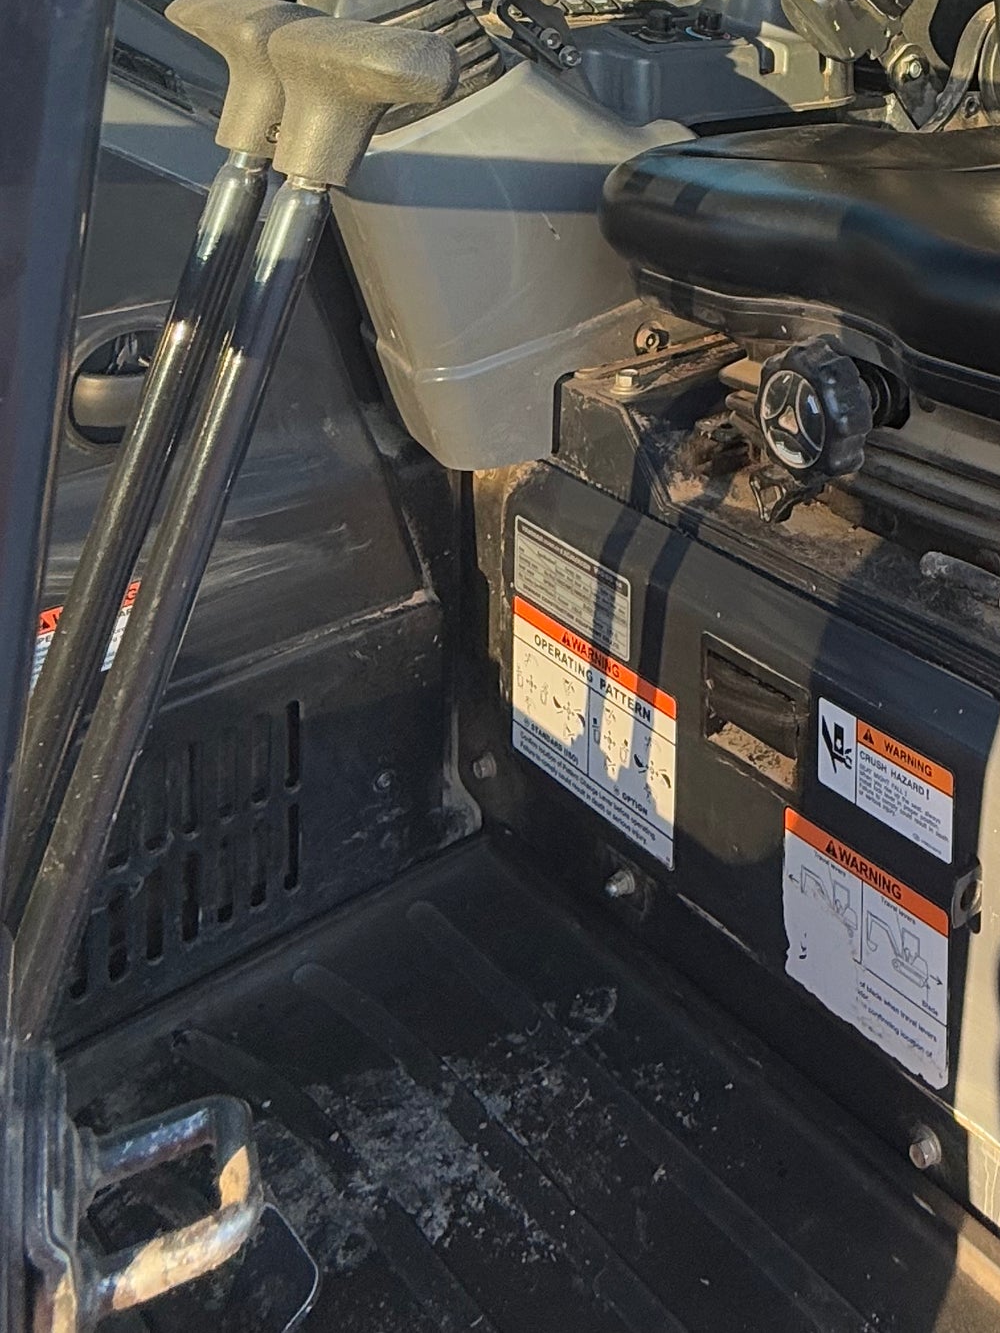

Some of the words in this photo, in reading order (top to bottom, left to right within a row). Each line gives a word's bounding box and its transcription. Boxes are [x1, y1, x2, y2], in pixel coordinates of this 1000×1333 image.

[571, 636, 619, 678] WARNING
[534, 634, 593, 683] OPERATING
[599, 677, 651, 723] PATTERN
[531, 723, 562, 751] STANDARD
[563, 747, 578, 765] (ISO)
[884, 739, 932, 777] WARNING
[622, 792, 647, 815] OPTION
[838, 846, 901, 900] WARNING
[881, 896, 897, 912] Travel
[898, 909, 916, 925] levers
